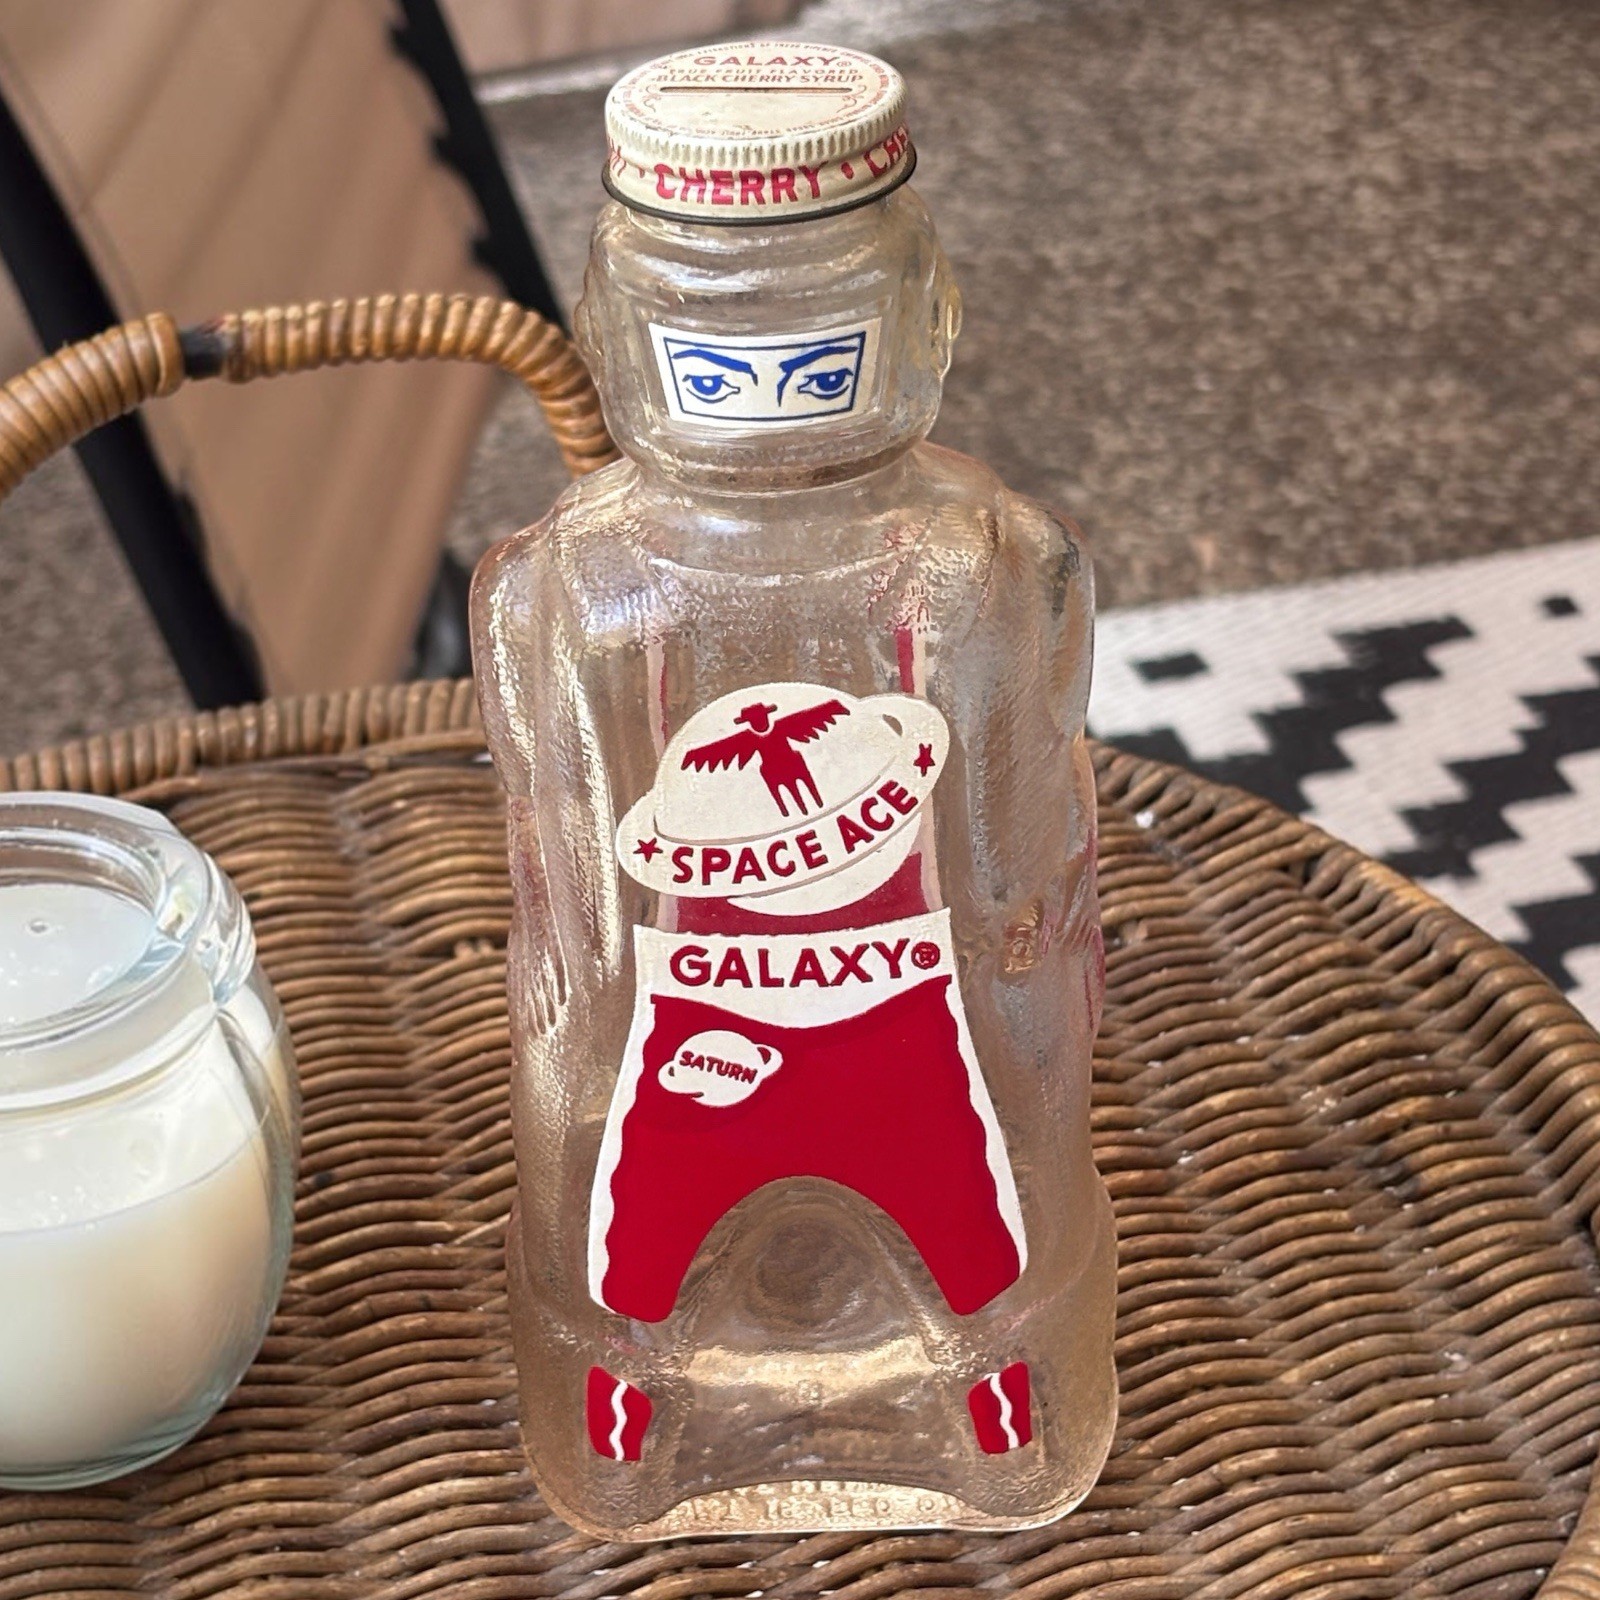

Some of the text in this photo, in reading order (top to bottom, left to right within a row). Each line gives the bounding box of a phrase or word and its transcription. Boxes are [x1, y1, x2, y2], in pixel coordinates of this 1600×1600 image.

[656, 74, 863, 83] BLACK CHERRY SYRUP
[653, 161, 829, 206] CHERRY
[671, 779, 919, 886] SPACE ACE
[678, 1050, 758, 1085] SATURN
